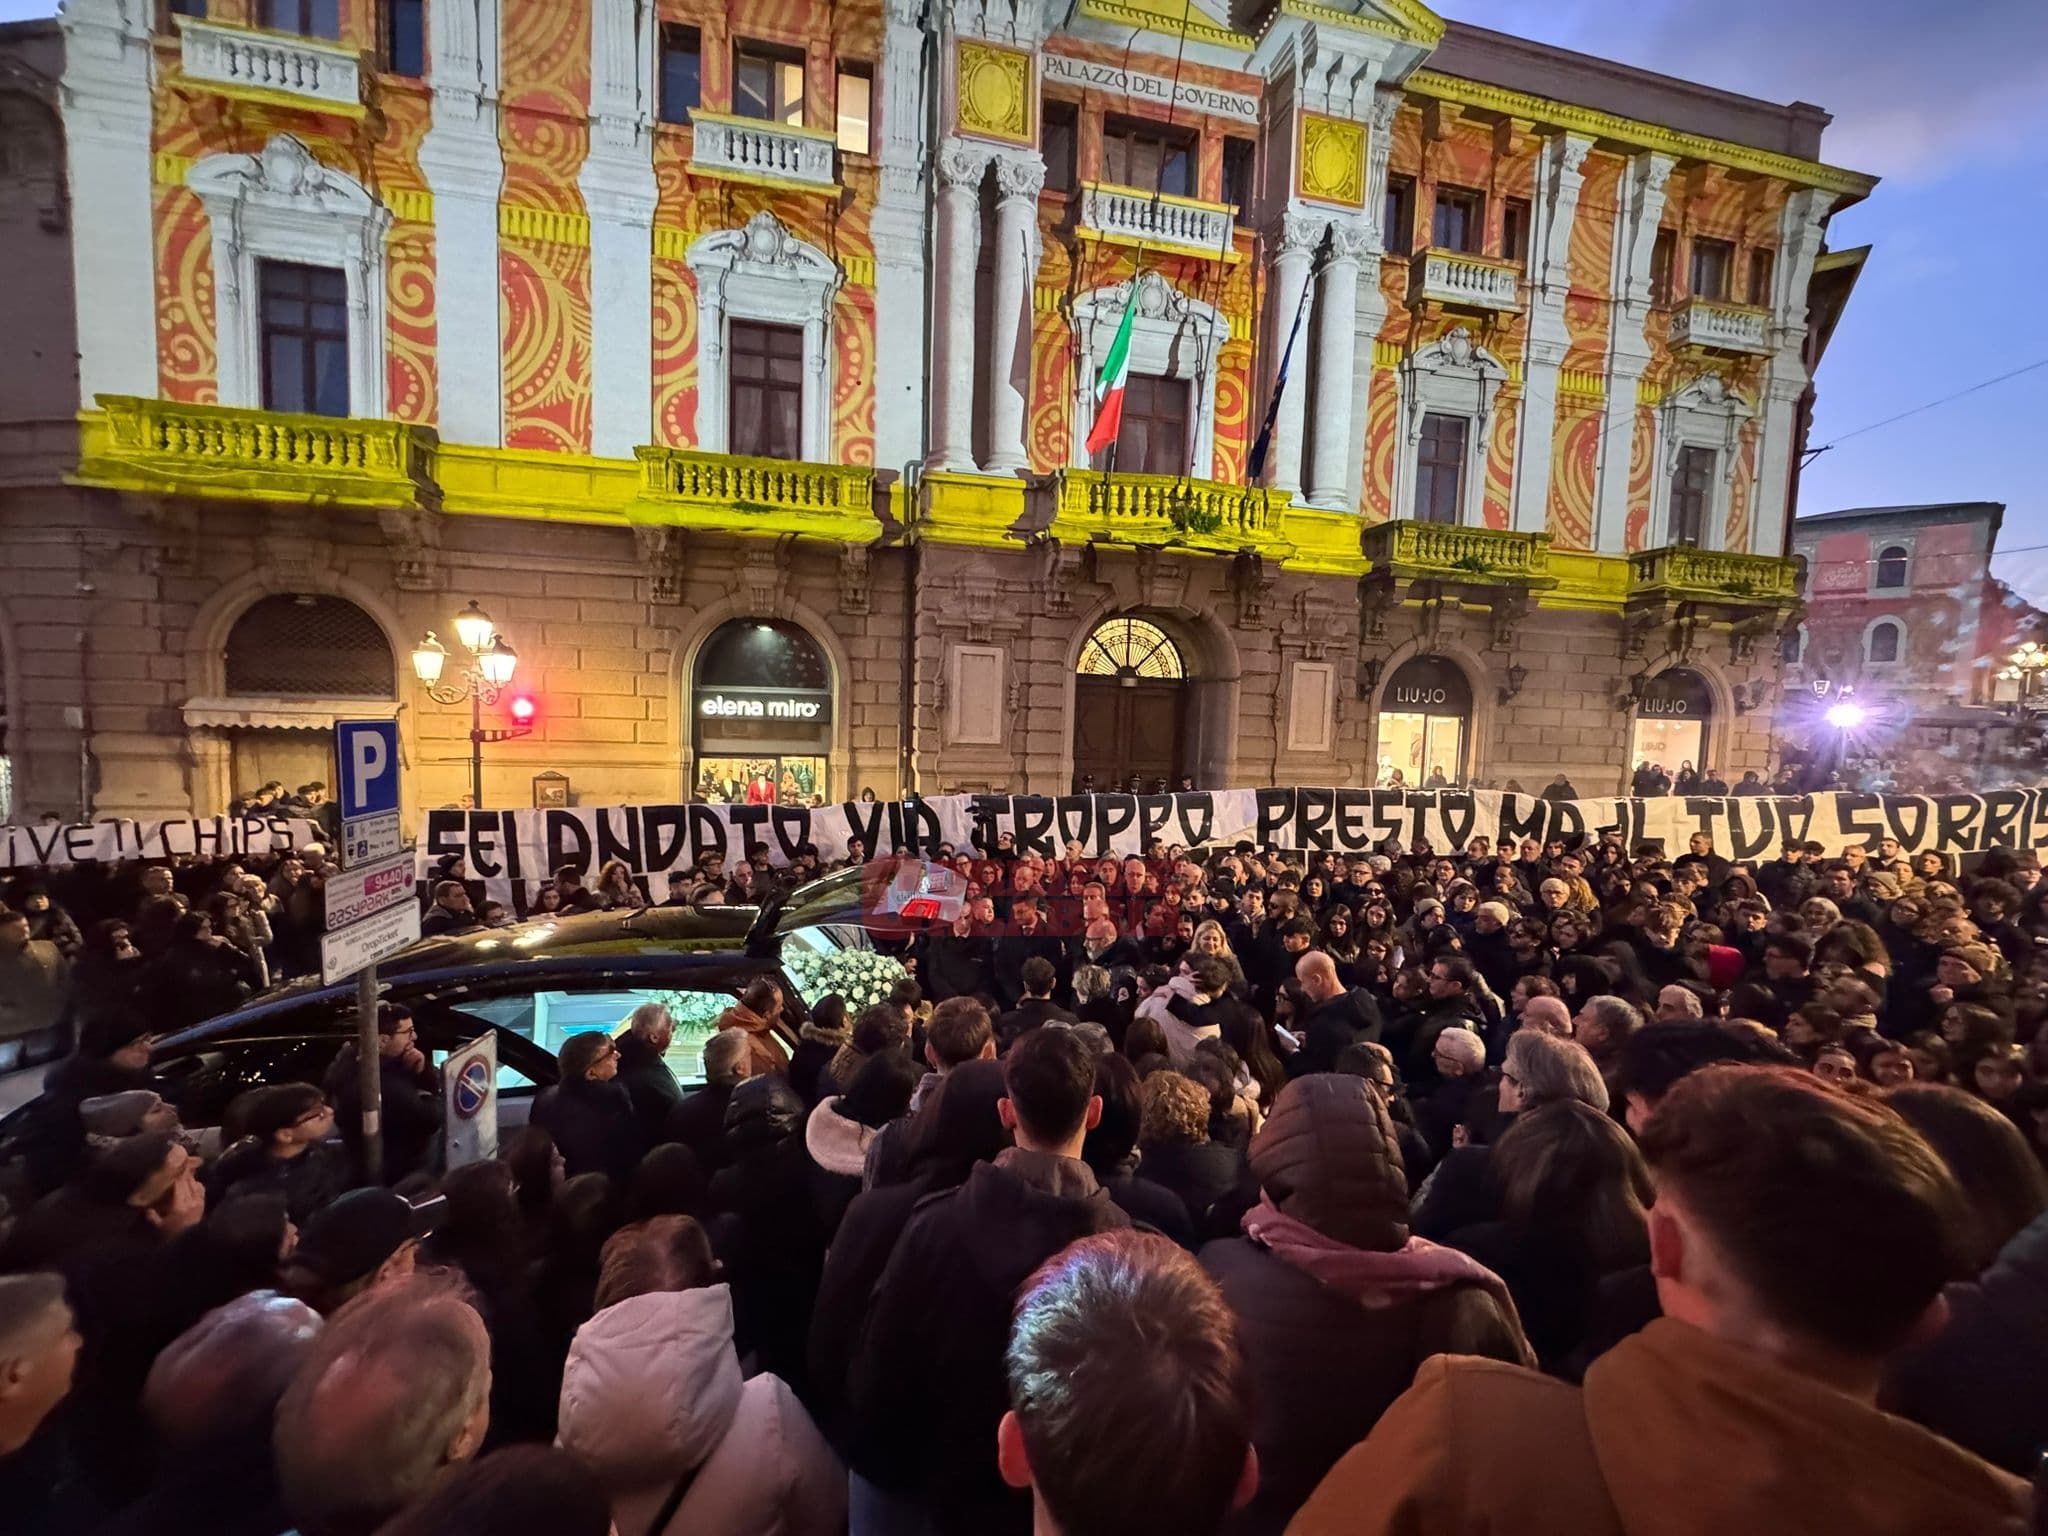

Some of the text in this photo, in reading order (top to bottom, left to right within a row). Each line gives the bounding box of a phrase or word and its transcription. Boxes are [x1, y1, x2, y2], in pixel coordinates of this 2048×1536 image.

[1045, 56, 1256, 116] PALAZZO DEL GOVERNO
[701, 695, 764, 717] elena
[352, 730, 388, 809] P
[428, 809, 521, 879] SEI
[546, 804, 812, 875] ANDATO
[843, 799, 942, 861] VIA
[971, 792, 1214, 853] TROPPO
[1256, 787, 1475, 852] PRESTO
[1500, 793, 1586, 852] MA
[1685, 796, 1814, 860] TUO
